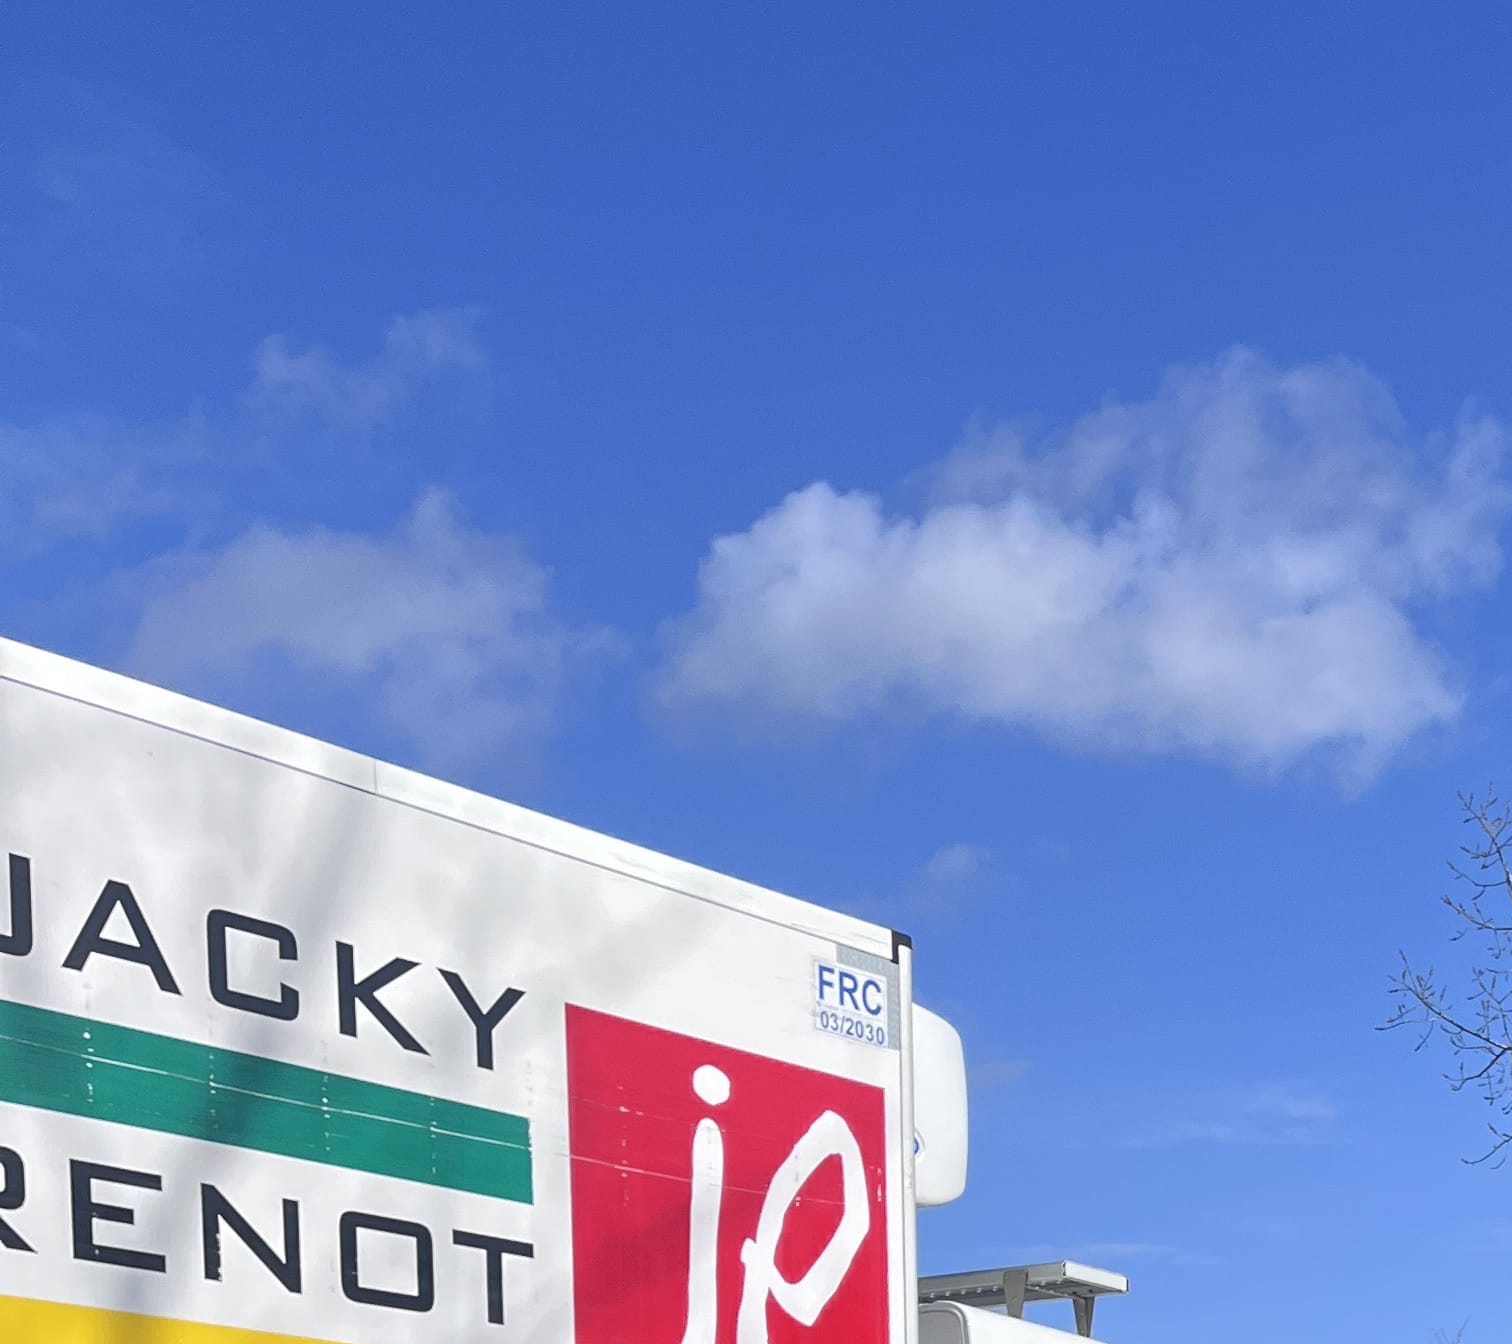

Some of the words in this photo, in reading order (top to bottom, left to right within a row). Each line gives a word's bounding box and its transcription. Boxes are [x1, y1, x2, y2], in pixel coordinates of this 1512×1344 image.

[0, 852, 526, 1071] JACKY
[818, 964, 882, 1016] FRC
[820, 1010, 885, 1045] 03/2030
